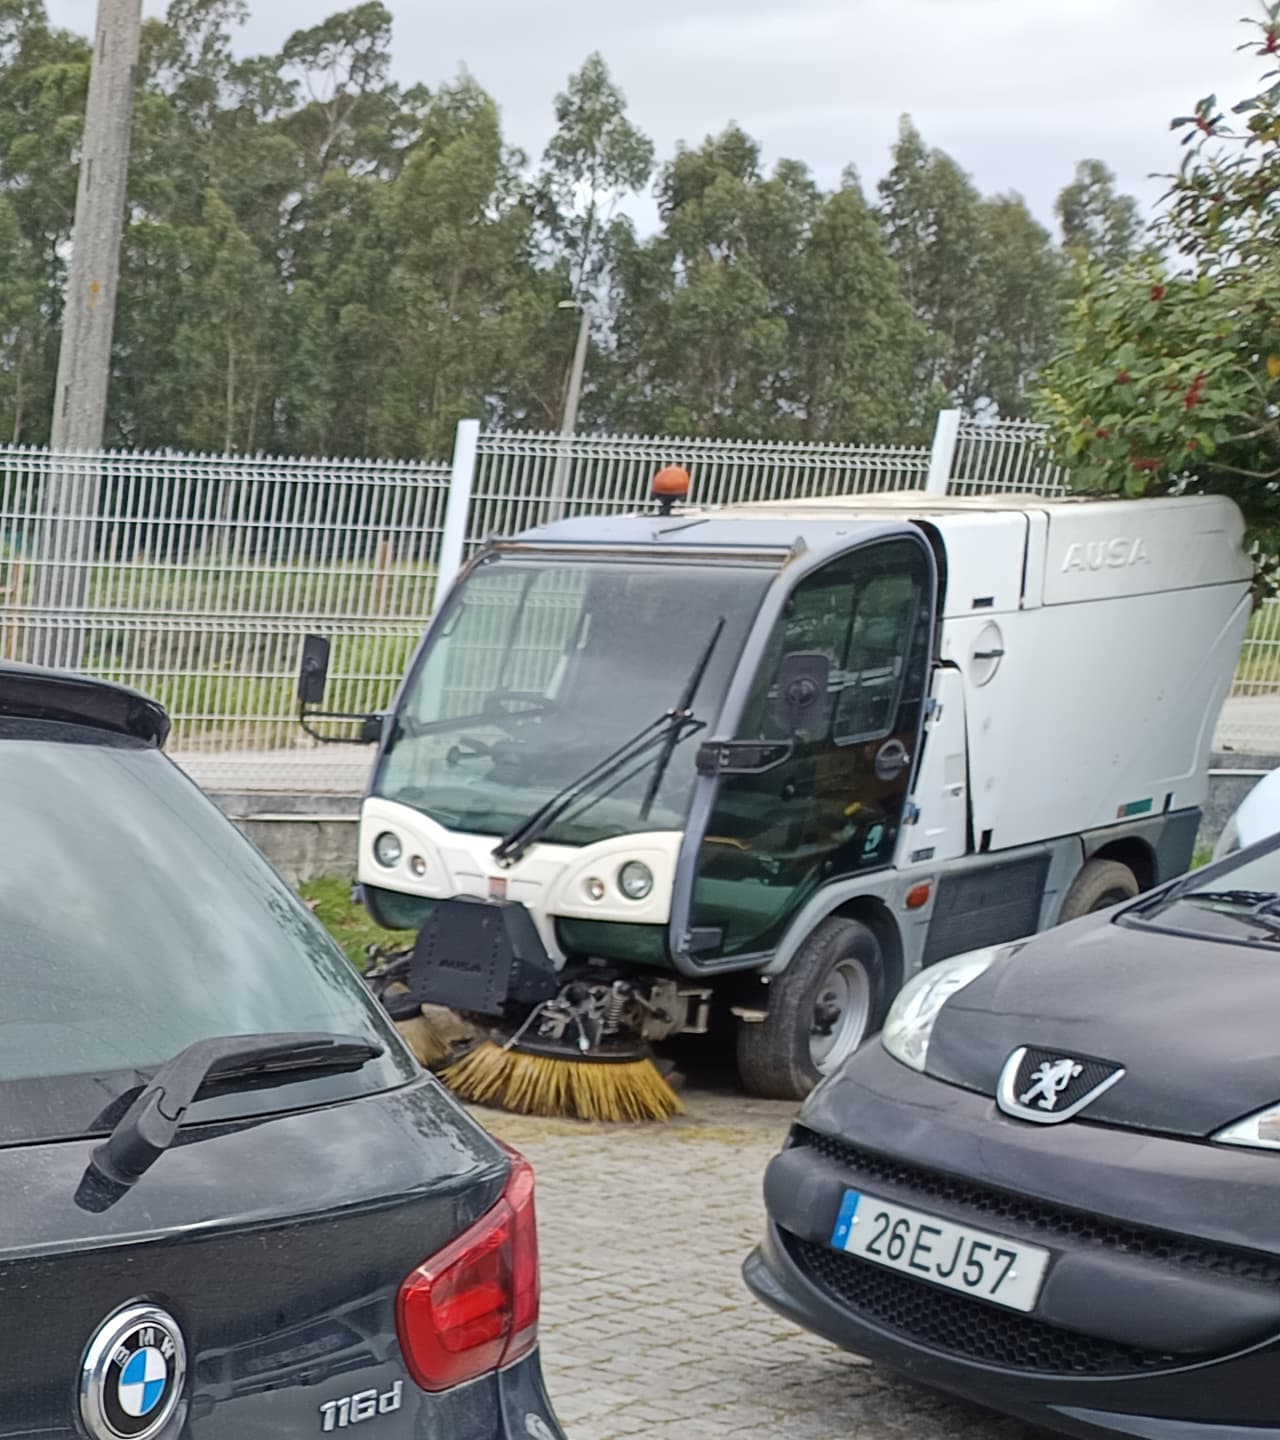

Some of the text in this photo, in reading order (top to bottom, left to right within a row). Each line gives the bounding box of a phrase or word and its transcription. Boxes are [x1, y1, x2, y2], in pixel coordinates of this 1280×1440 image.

[1060, 537, 1153, 574] AUSA
[865, 1212, 1017, 1294] 26EJ57
[112, 1327, 176, 1368] BMW
[320, 1380, 403, 1431] 116d
